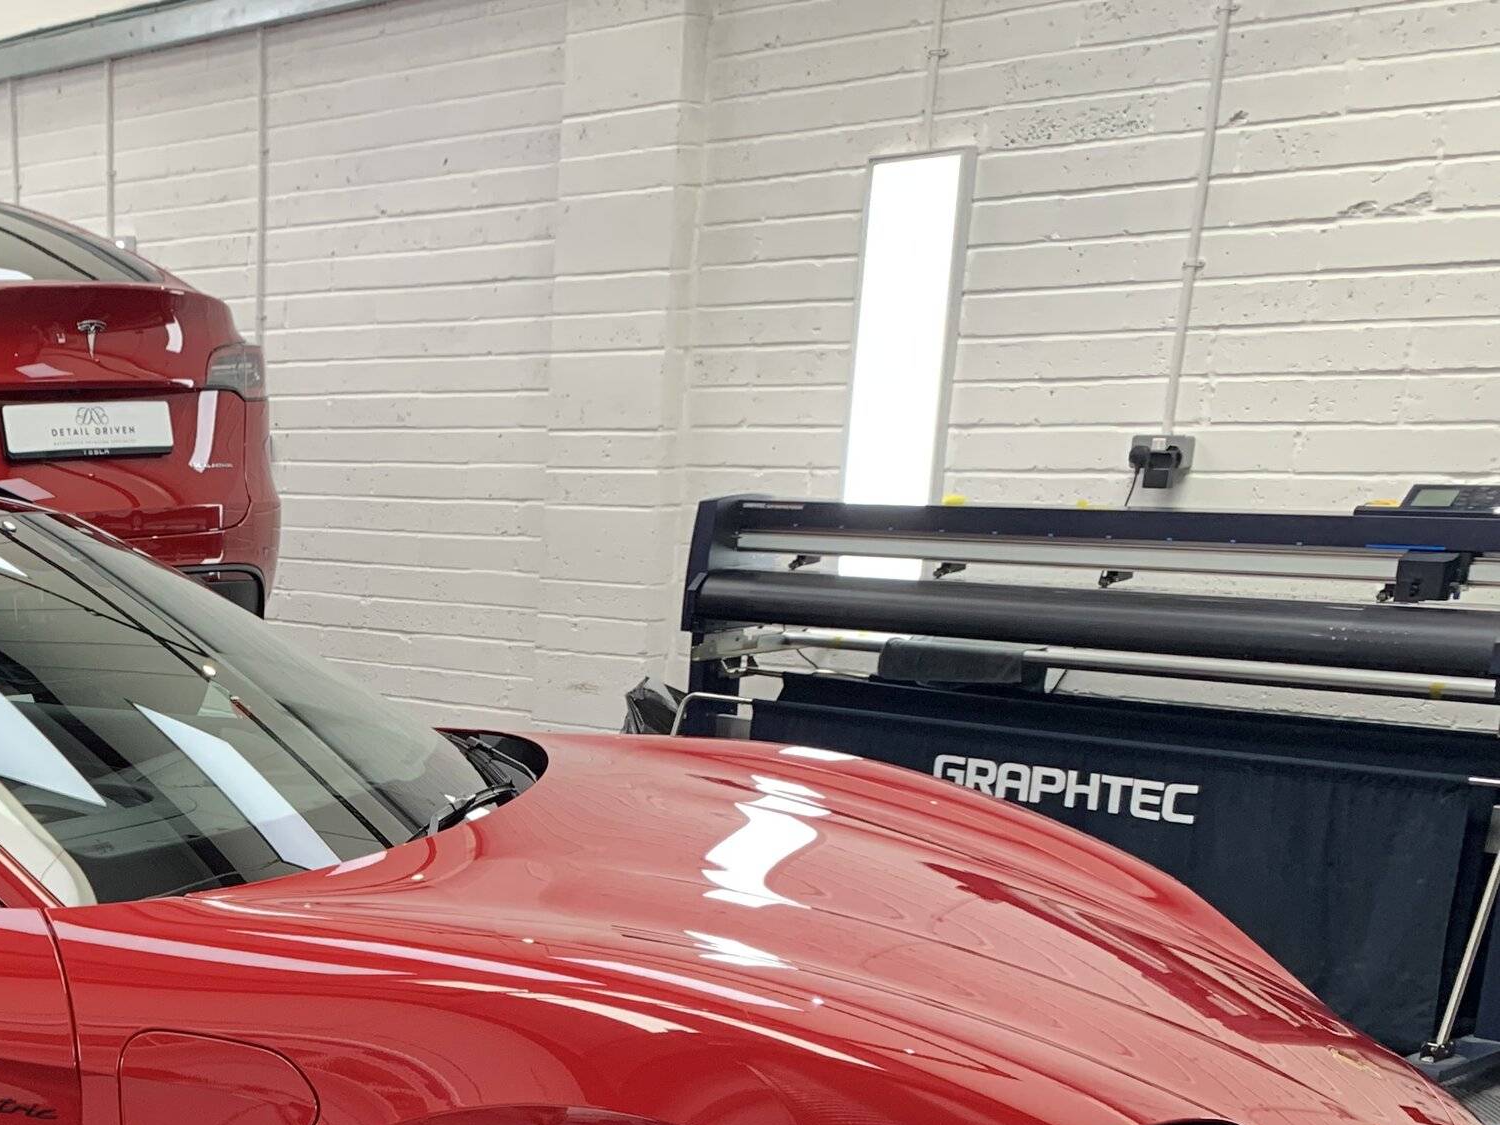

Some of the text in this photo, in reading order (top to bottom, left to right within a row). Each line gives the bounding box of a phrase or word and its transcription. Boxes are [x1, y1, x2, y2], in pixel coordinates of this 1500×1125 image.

[51, 426, 136, 437] DETAIL DRIVEN
[933, 754, 1199, 825] GRAPHTEC
